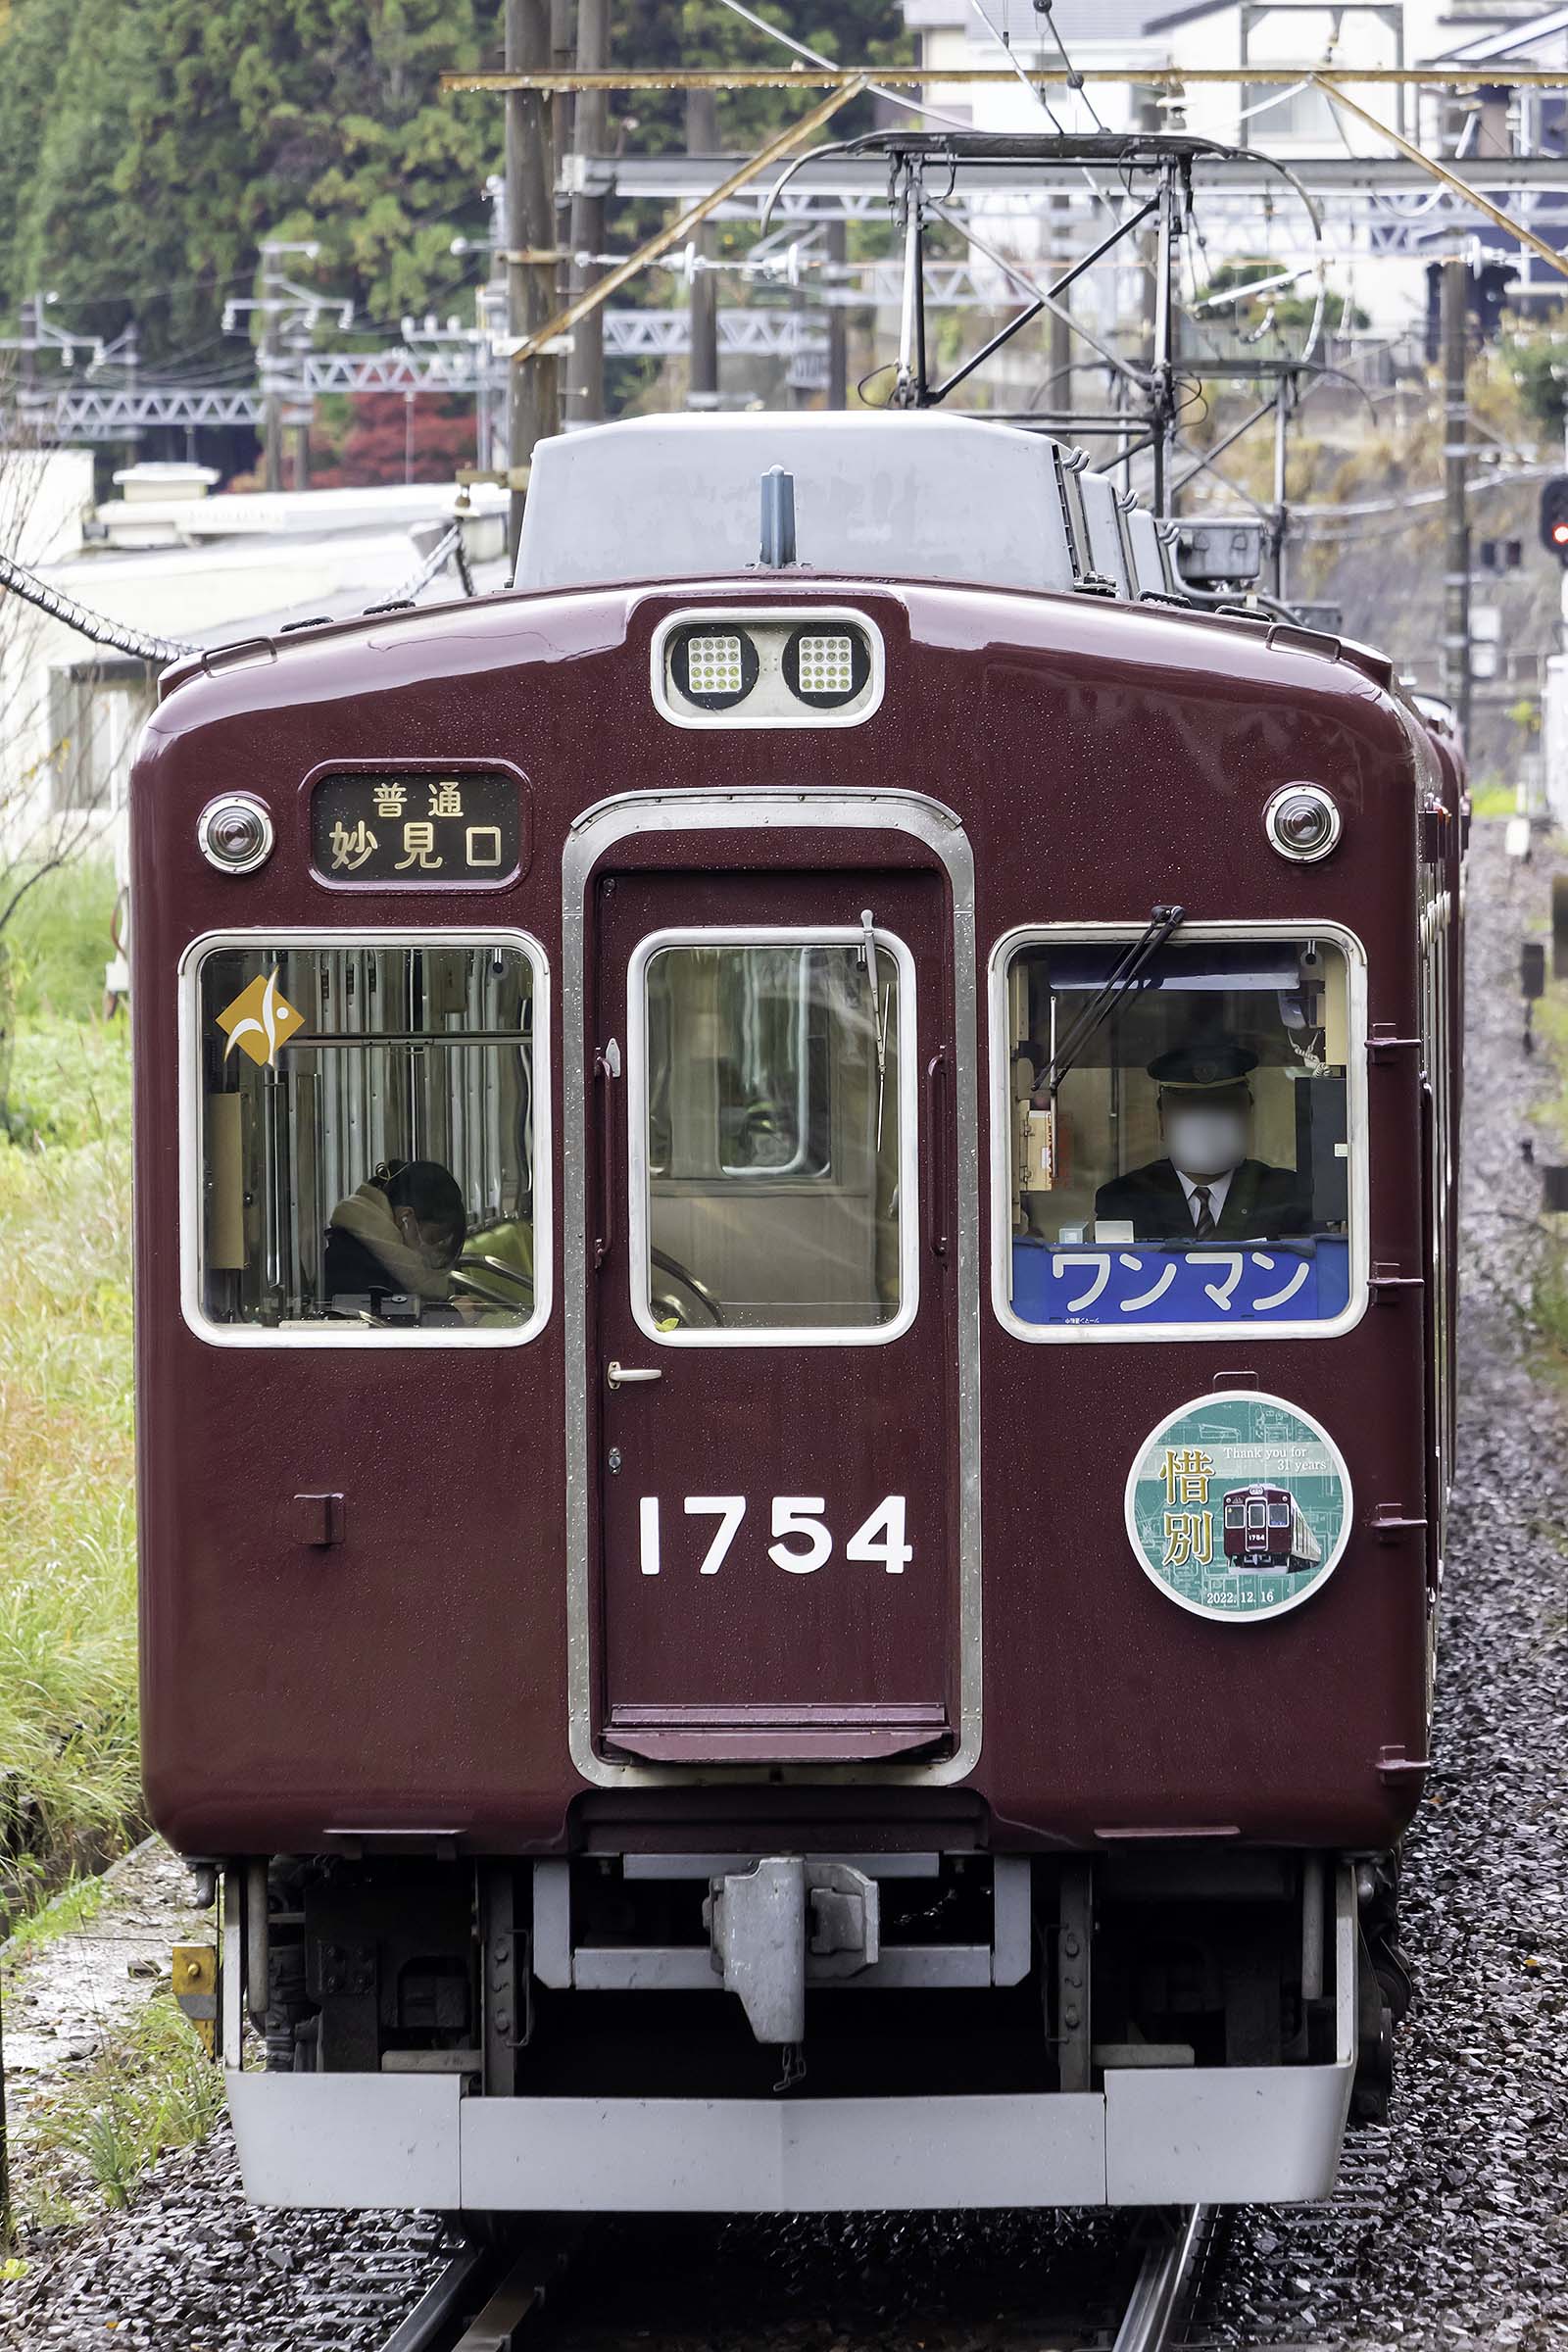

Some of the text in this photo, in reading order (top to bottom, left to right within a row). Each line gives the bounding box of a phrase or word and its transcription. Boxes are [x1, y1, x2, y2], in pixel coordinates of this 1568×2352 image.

[372, 782, 465, 818] 普通
[328, 819, 502, 870] 妙見口
[1052, 1251, 1310, 1313] ワンマン
[1223, 1446, 1307, 1459] Thank you for
[1277, 1459, 1327, 1472] 31 years
[1158, 1448, 1216, 1567] 惜別
[639, 1495, 913, 1575] 1754
[1206, 1591, 1274, 1604] 2022. 12. 16
